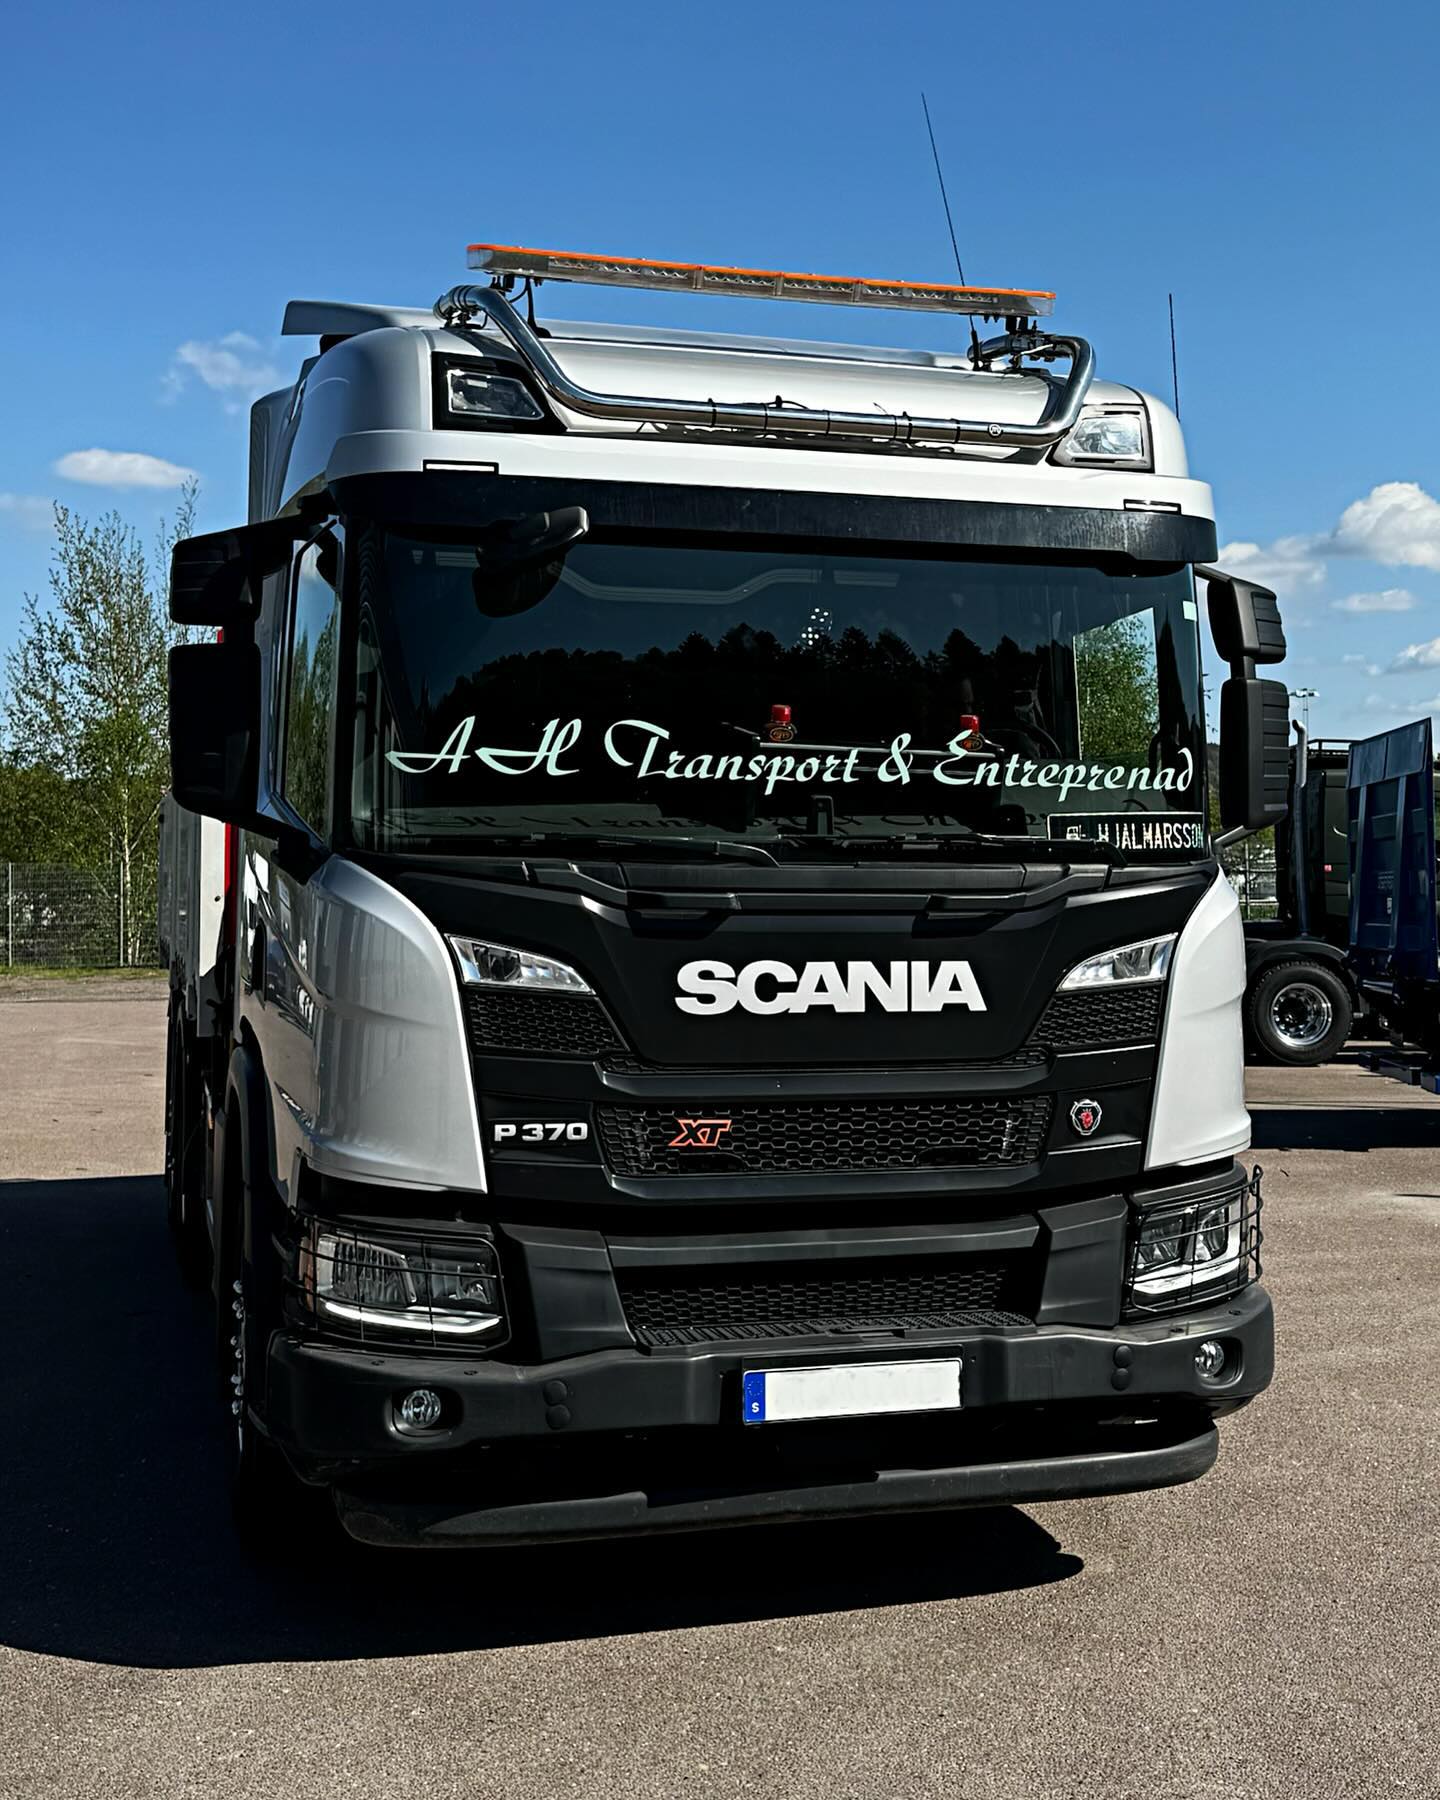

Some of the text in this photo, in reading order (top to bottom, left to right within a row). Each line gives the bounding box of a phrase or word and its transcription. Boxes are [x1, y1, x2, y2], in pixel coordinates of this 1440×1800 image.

[604, 719, 859, 796] Transport
[877, 732, 914, 786] &
[932, 729, 1193, 802] Entreprenad
[674, 959, 988, 1016] SCANIA
[494, 1122, 588, 1142] P 370
[669, 1118, 732, 1147] XT
[751, 1402, 760, 1413] S
